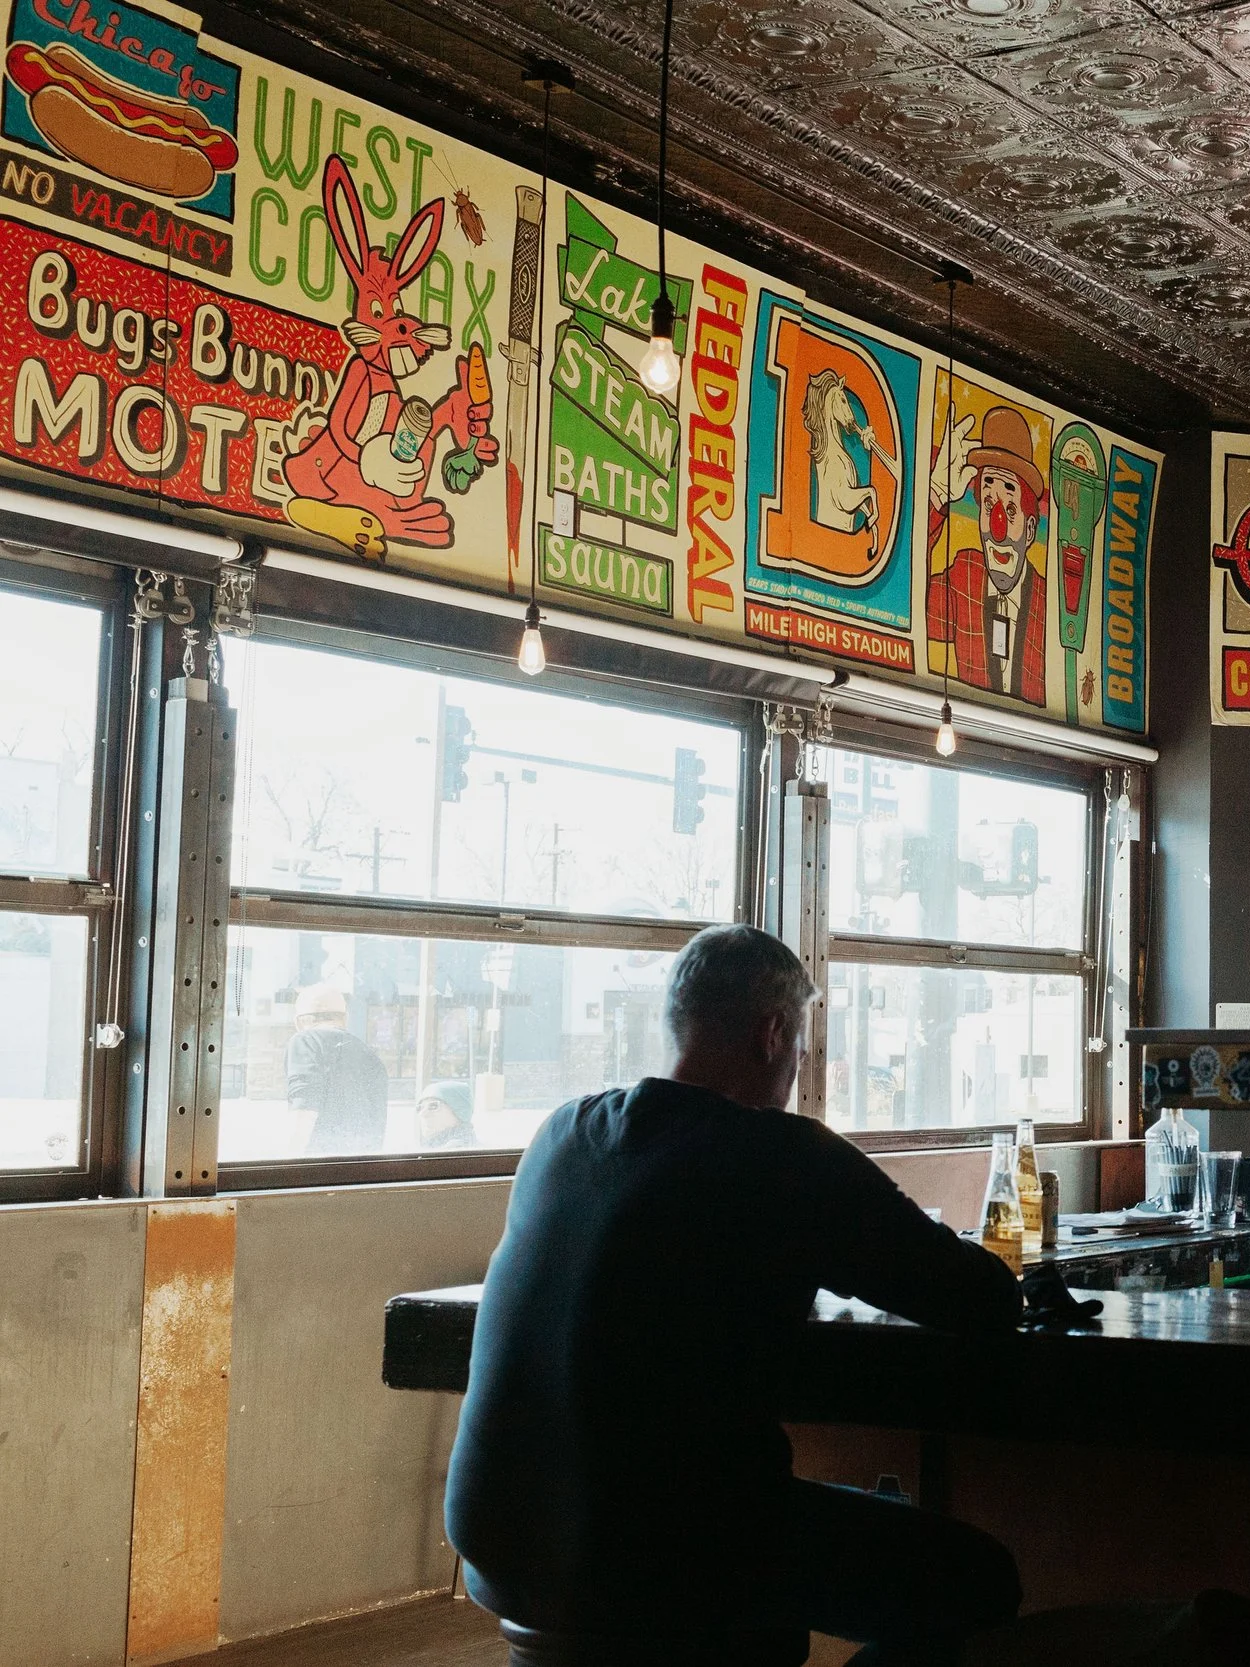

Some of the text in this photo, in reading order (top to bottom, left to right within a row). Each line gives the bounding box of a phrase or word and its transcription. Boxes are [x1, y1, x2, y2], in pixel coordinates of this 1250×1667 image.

[3, 160, 228, 264] NO VACANCY
[253, 76, 433, 220] WEST
[28, 251, 181, 373] Bugs
[249, 186, 496, 358] COAX
[566, 249, 654, 331] Lak
[13, 357, 297, 502] MOTE
[560, 337, 674, 472] STEAM
[687, 263, 749, 624] FEDERAL
[554, 444, 671, 523] BATHS
[749, 609, 910, 664] MILE HIGH STADIUM
[1107, 454, 1142, 704] BROADWAY
